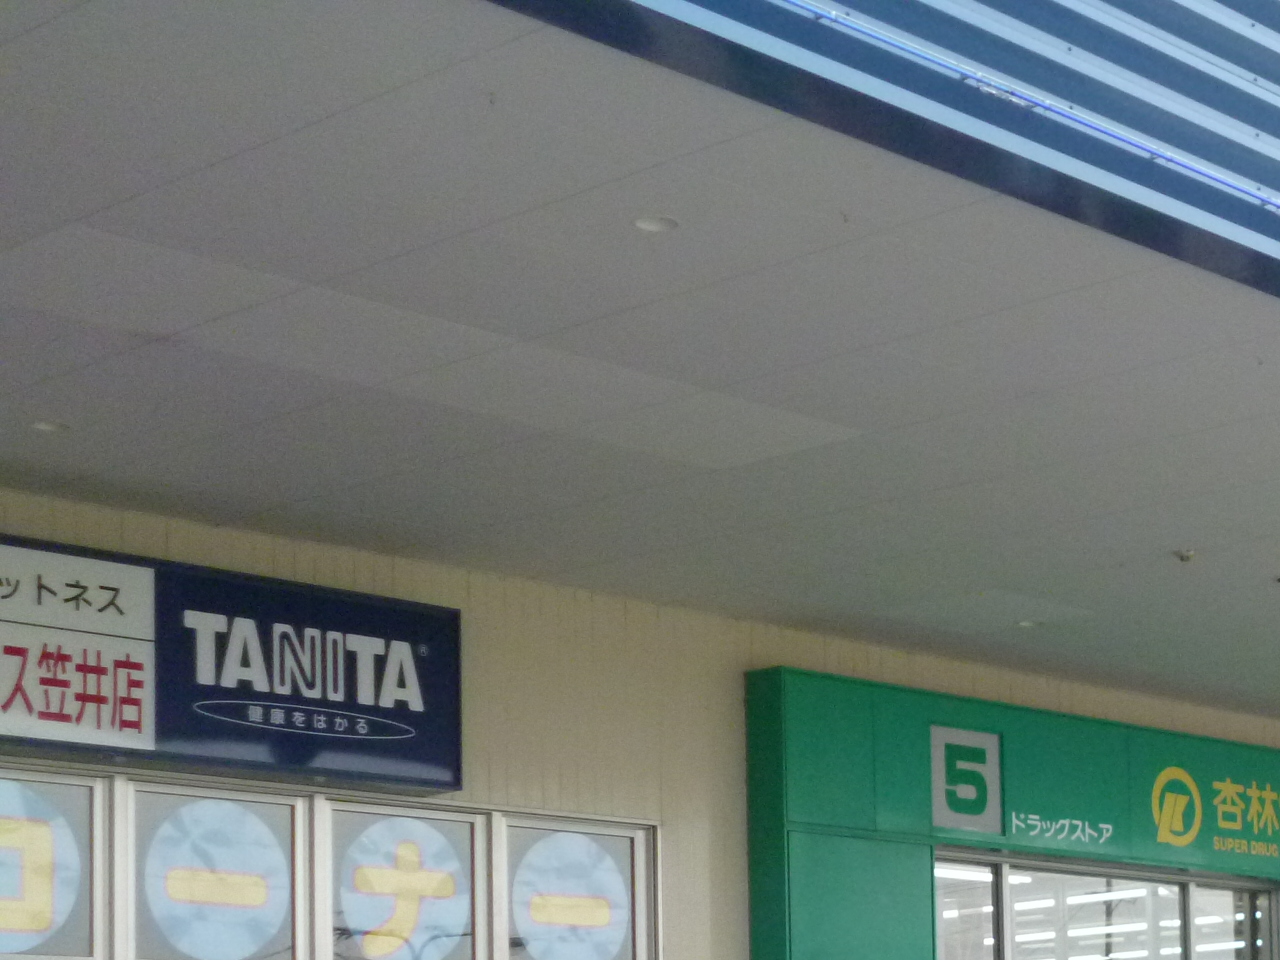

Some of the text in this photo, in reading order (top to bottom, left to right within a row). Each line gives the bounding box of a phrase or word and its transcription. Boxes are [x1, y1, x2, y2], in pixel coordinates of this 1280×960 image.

[183, 609, 425, 712] TANITA
[1, 642, 145, 734] ス笠井店
[247, 704, 369, 735] 健康をはかる
[944, 742, 988, 816] 5
[1010, 811, 1113, 845] ドラッグストア
[1213, 836, 1249, 854] SUPER
[1250, 842, 1279, 857] DRUG
